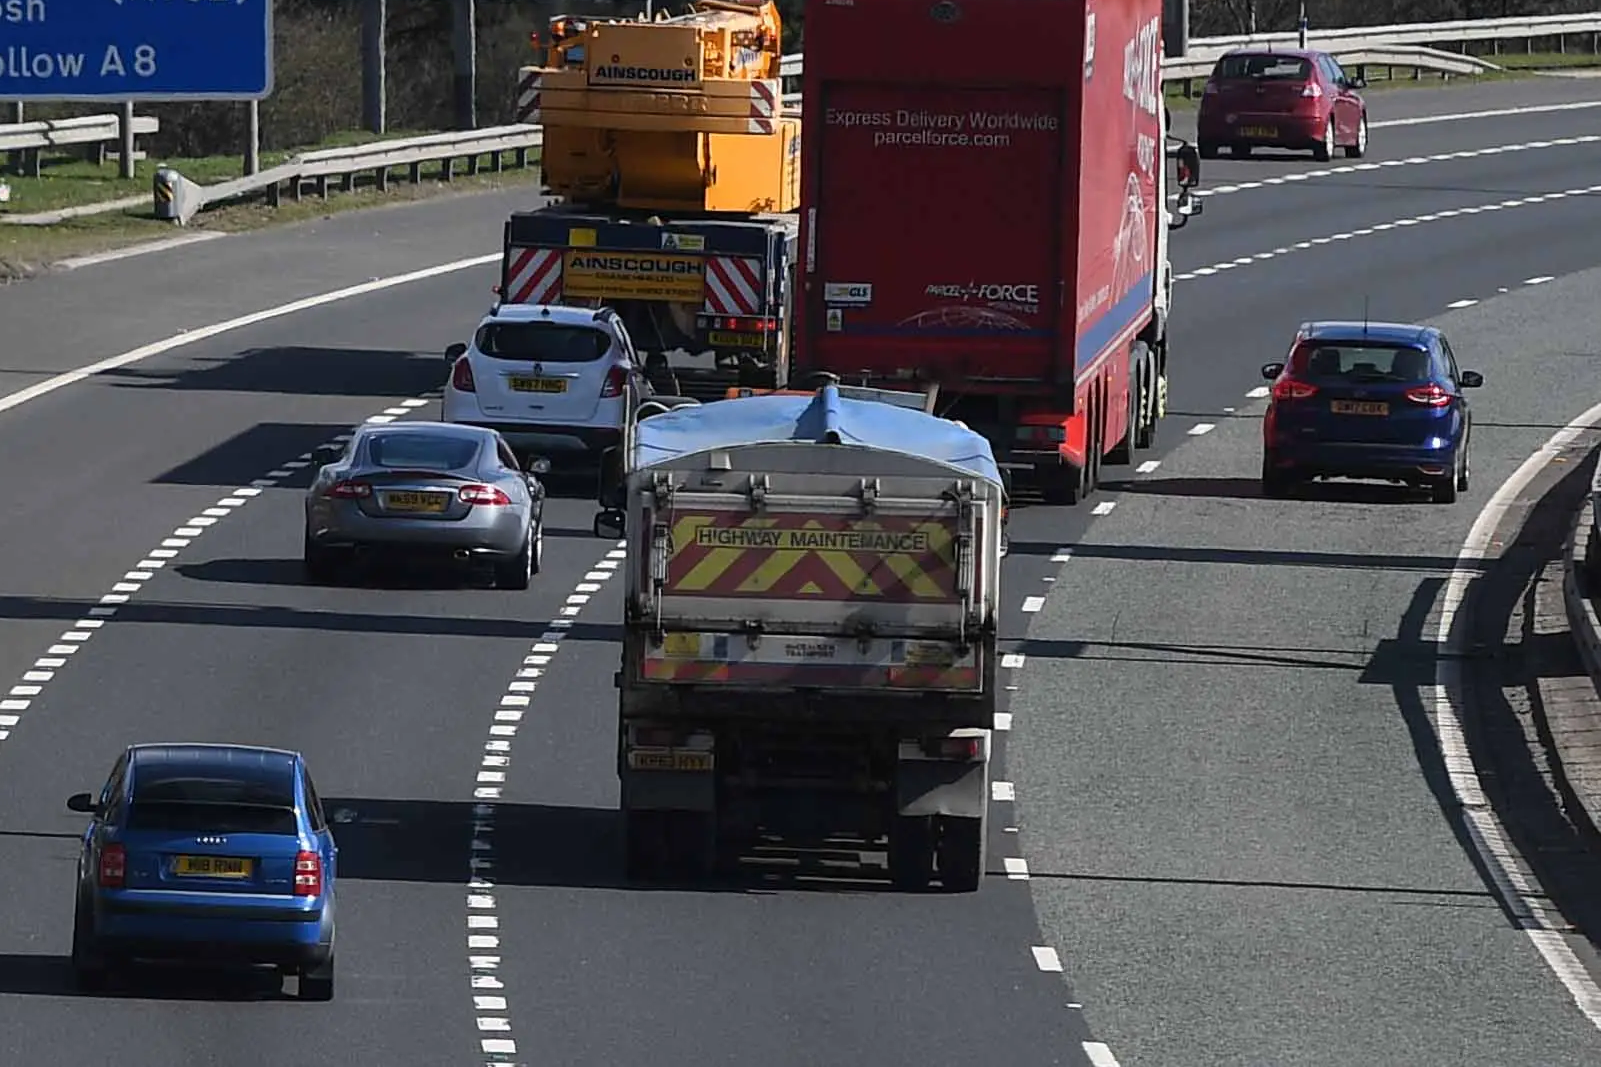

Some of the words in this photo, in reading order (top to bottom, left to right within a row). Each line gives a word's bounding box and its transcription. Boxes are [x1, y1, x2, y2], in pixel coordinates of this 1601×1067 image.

[595, 64, 696, 82] AINSCOUGH
[826, 109, 892, 129] Express
[896, 110, 965, 130] Delivery
[970, 111, 1058, 131] Worldwide
[874, 129, 1011, 147] parcelforce.com
[569, 256, 702, 274] AINSCOUGH
[699, 529, 782, 546] HIGHWAY
[790, 531, 925, 551] MAINTENANCE
